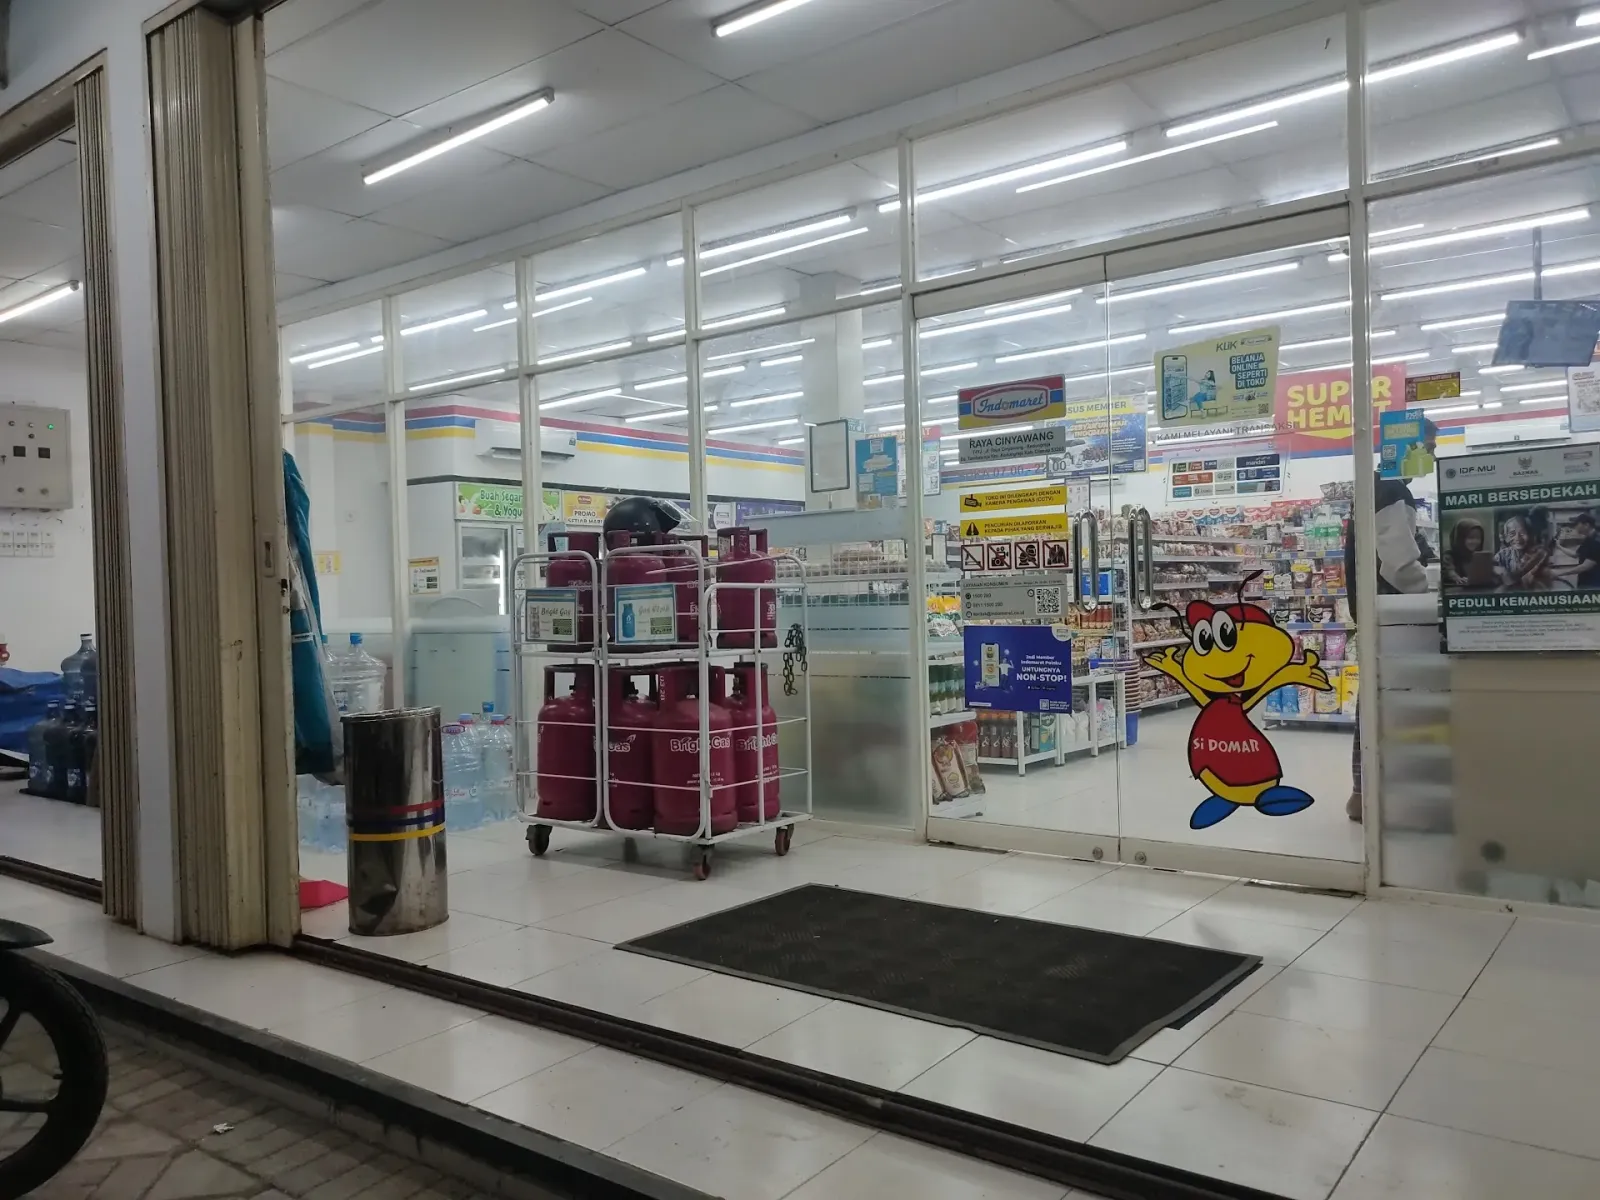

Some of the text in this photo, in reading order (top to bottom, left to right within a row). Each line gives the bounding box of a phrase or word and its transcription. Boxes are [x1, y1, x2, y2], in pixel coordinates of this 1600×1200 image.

[1231, 353, 1264, 364] BELANJA
[1231, 362, 1258, 372] ONLINE
[1237, 369, 1267, 380] SEPERTI
[1237, 378, 1265, 388] DI TOKO
[1287, 375, 1392, 408] SUPR
[976, 392, 1044, 413] Indomaret
[1086, 401, 1127, 412] MEMER
[1287, 400, 1392, 429] HEMT
[969, 431, 1054, 449] RAYA CINYAWANG
[480, 489, 523, 505] Buah Segar
[1445, 483, 1598, 507] MARI BERSEDEKAH
[494, 504, 523, 517] & Yogu
[1448, 594, 1600, 609] PEDULI KEMANUSIAAN
[1016, 672, 1067, 683] NON-STOP!
[1021, 666, 1061, 674] UNTUNGNYA
[670, 736, 711, 753] Brig
[1207, 738, 1260, 754] DOMAR
